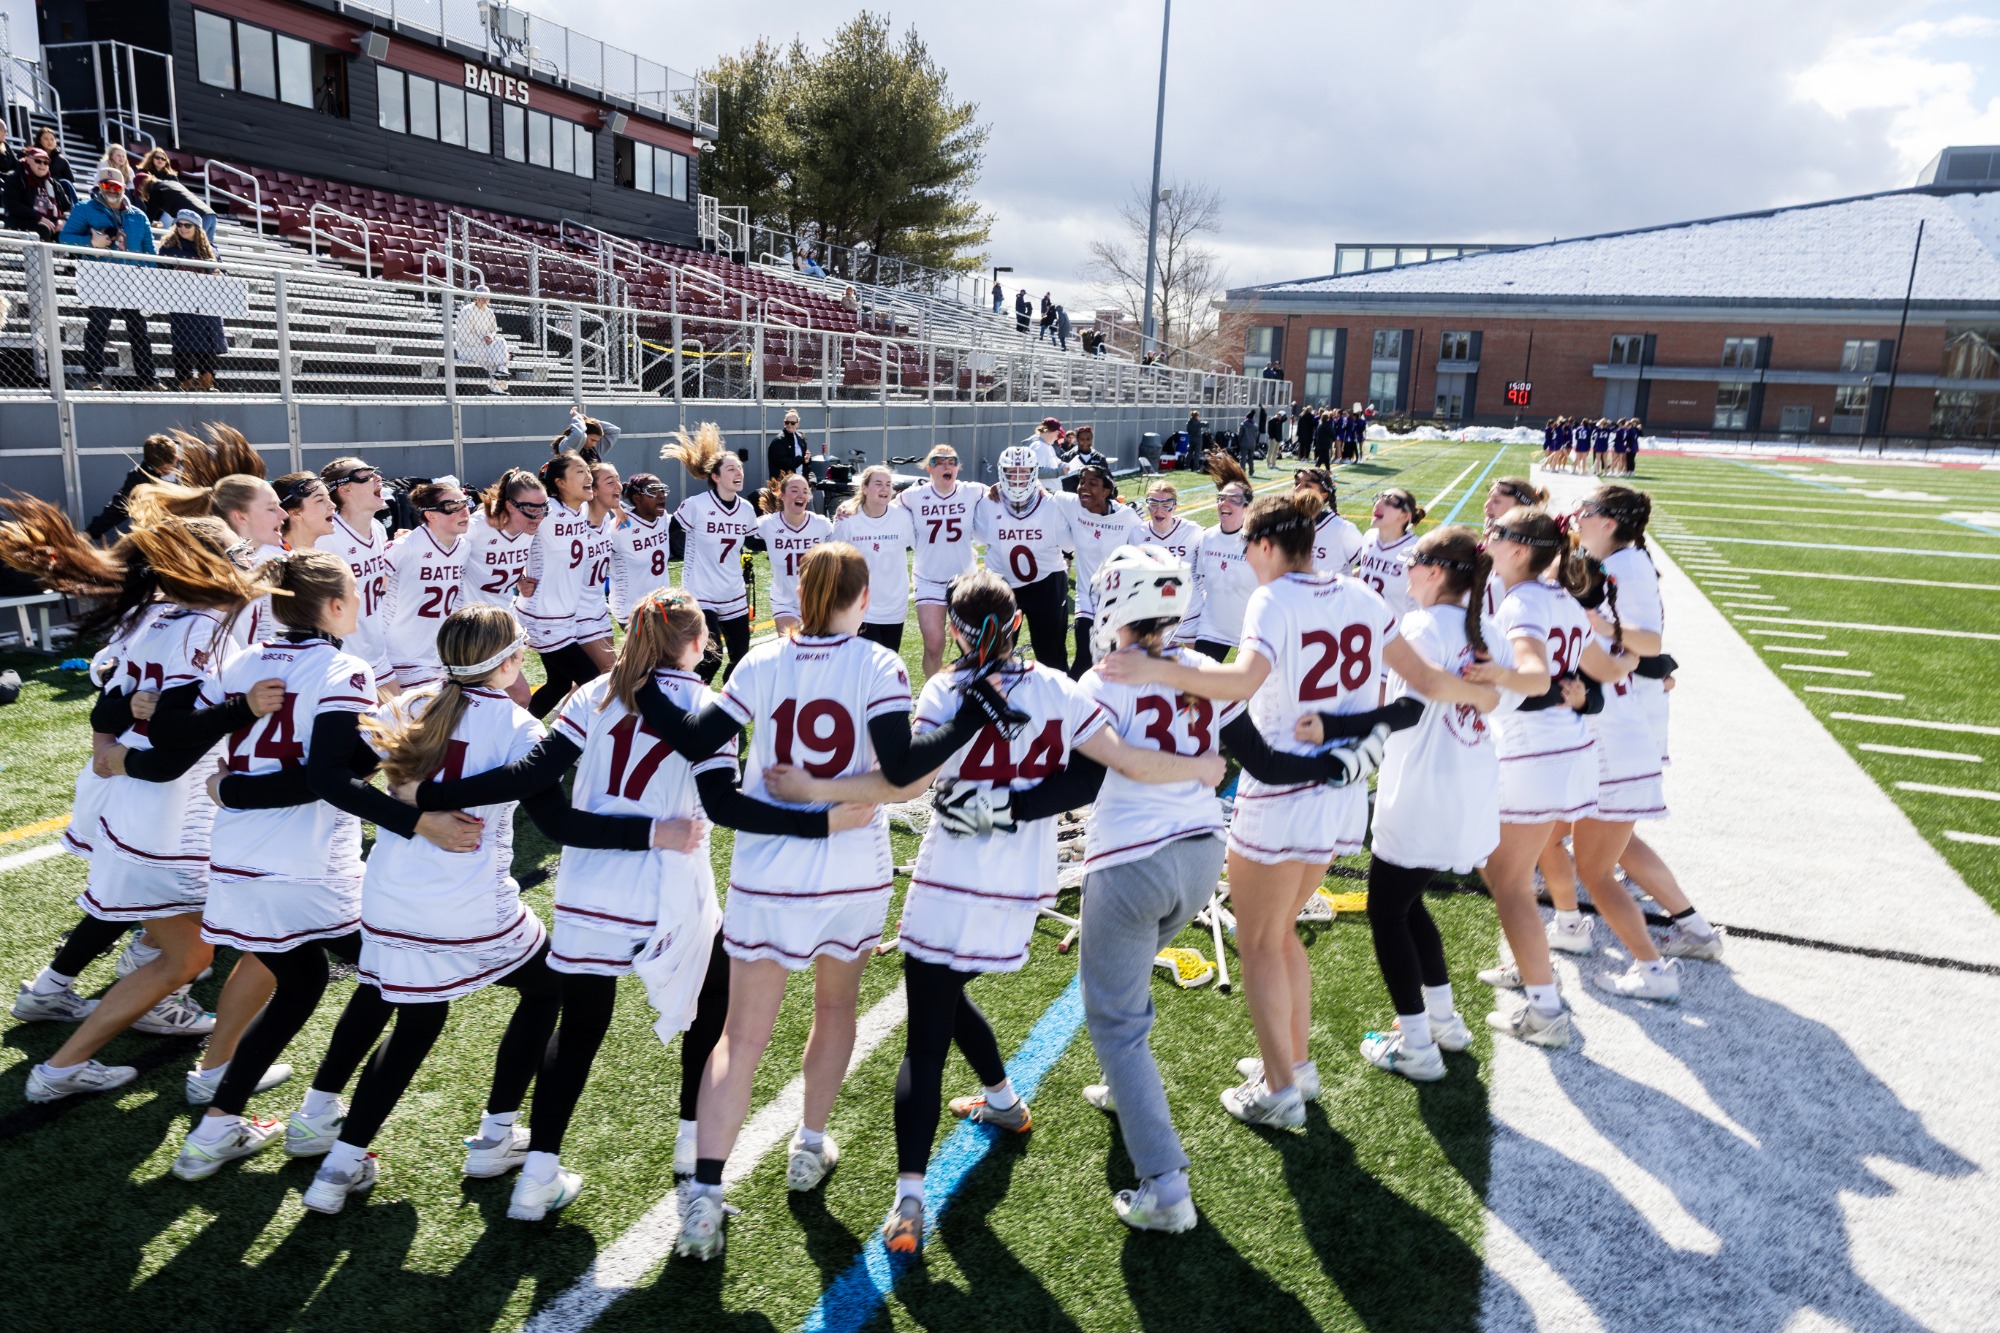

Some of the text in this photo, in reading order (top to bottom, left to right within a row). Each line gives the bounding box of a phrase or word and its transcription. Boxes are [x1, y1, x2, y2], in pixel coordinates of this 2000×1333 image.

[464, 63, 529, 105] BATES
[1508, 390, 1528, 405] 90
[1509, 382, 1531, 391] 15:00
[921, 503, 966, 516] BATES
[632, 529, 667, 551] BATES
[707, 522, 747, 535] BATES
[926, 518, 962, 544] 75
[998, 529, 1043, 540] BATES
[486, 548, 529, 565] BATES
[569, 539, 583, 569] 9
[651, 550, 664, 576] 8
[719, 538, 737, 563] 7
[1009, 544, 1038, 582] 0
[588, 557, 610, 586] 10
[1362, 555, 1402, 576] BATES
[480, 566, 525, 594] 27
[1105, 571, 1120, 591] 33
[418, 585, 459, 619] 20
[1299, 623, 1372, 702] 28
[1547, 627, 1583, 682] 30
[224, 692, 305, 772] 24
[770, 698, 855, 779] 19
[1135, 695, 1213, 757] 33
[605, 713, 676, 801] 17
[960, 720, 1066, 788] 44
